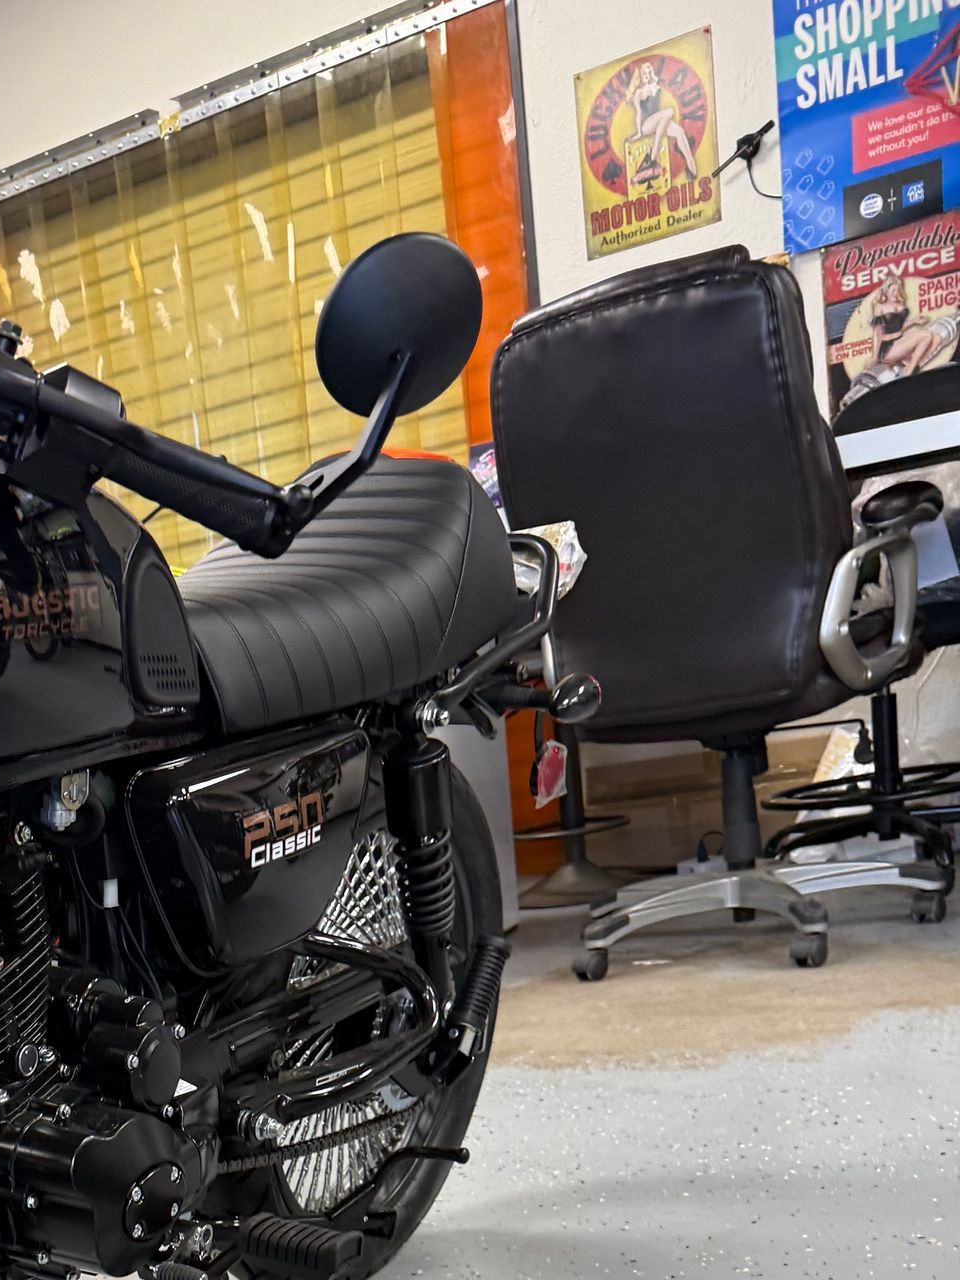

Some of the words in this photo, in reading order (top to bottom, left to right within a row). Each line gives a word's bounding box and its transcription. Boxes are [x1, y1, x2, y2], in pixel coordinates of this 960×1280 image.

[794, 0, 960, 60] SHOPP
[796, 35, 904, 109] SMALL
[588, 67, 632, 161] LUCKY
[656, 58, 706, 122] LADY
[867, 119, 883, 132] We
[885, 112, 905, 124] love
[906, 107, 925, 120] our
[867, 135, 882, 145] we
[883, 119, 925, 140] couldn't
[927, 113, 940, 126] do
[867, 137, 907, 158] without
[907, 130, 930, 148] you!
[590, 192, 662, 237] MOTOR
[666, 176, 713, 212] OILS
[600, 220, 661, 247] Authorized
[667, 210, 704, 228] Dealer
[835, 223, 960, 275] Dependable
[841, 246, 955, 291] SERVICE
[836, 350, 849, 363] ON
[851, 346, 874, 358] DUTY
